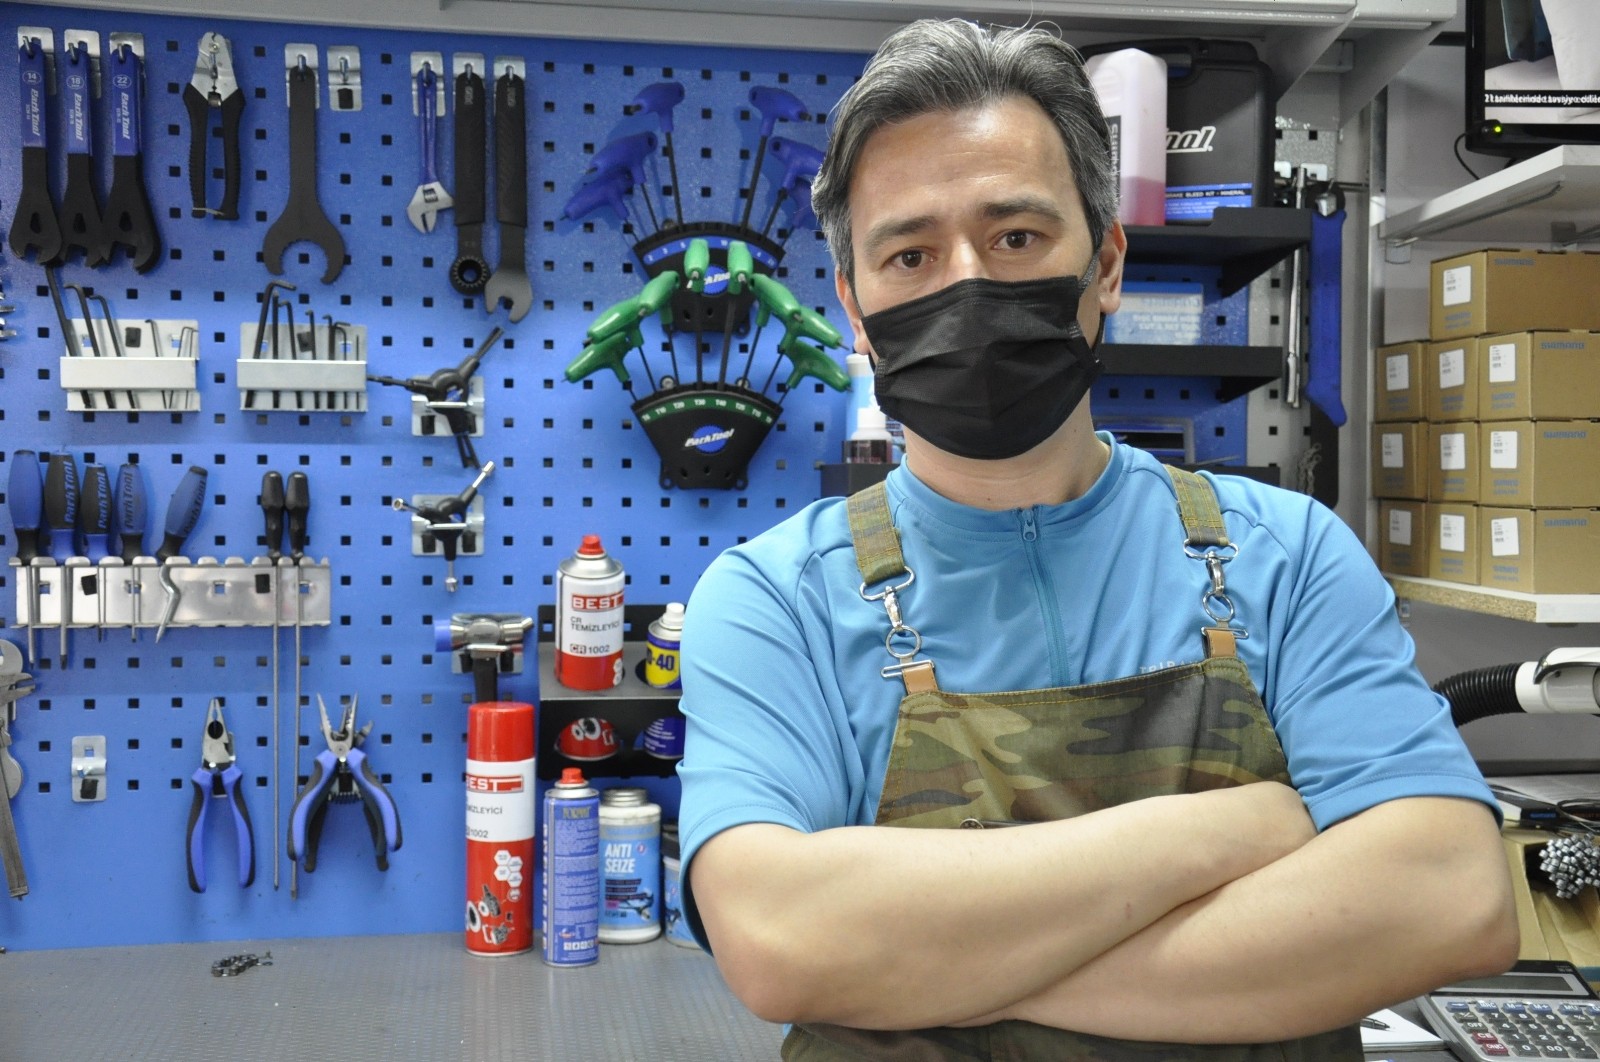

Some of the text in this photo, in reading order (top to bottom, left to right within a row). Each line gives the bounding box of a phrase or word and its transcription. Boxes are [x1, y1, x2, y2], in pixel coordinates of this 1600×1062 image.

[117, 76, 128, 84] 22
[572, 593, 621, 610] BEST
[588, 644, 610, 654] 1002
[605, 843, 632, 858] ANTI
[605, 858, 636, 873] SEIZE
